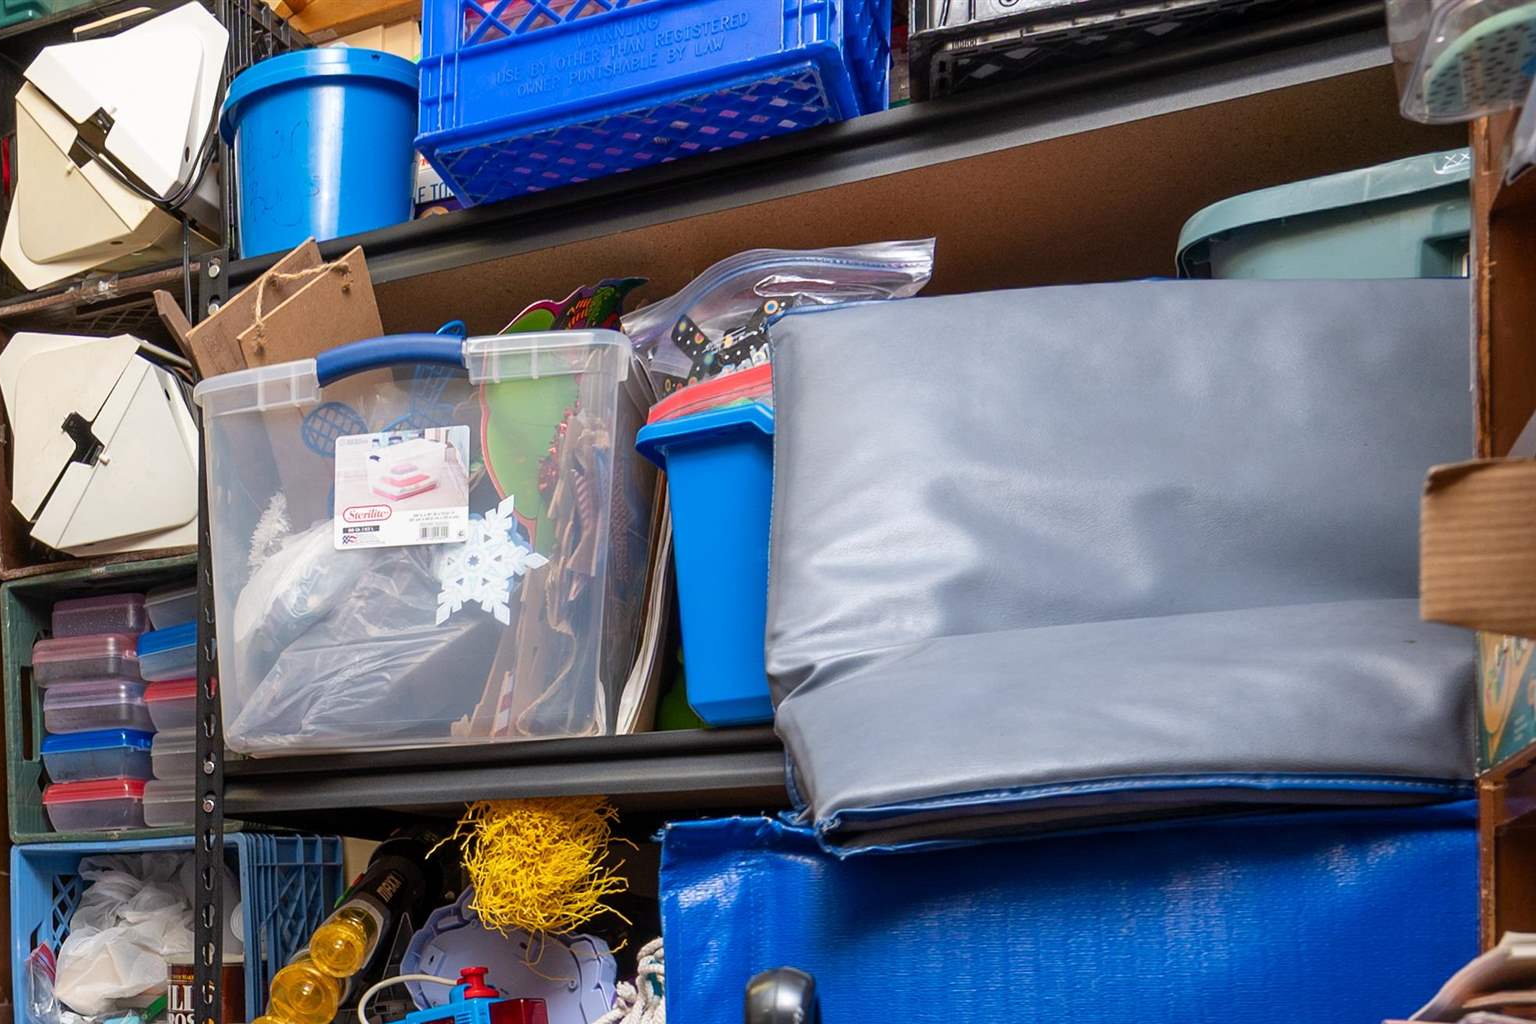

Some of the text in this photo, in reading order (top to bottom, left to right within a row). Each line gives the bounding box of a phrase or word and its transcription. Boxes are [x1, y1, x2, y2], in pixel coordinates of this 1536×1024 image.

[555, 48, 601, 71] OTHER
[609, 38, 647, 59] THAN
[655, 11, 749, 47] REGISTERED
[575, 12, 662, 47] WARNING
[695, 37, 727, 58] LAW
[348, 508, 386, 520] Sterilite
